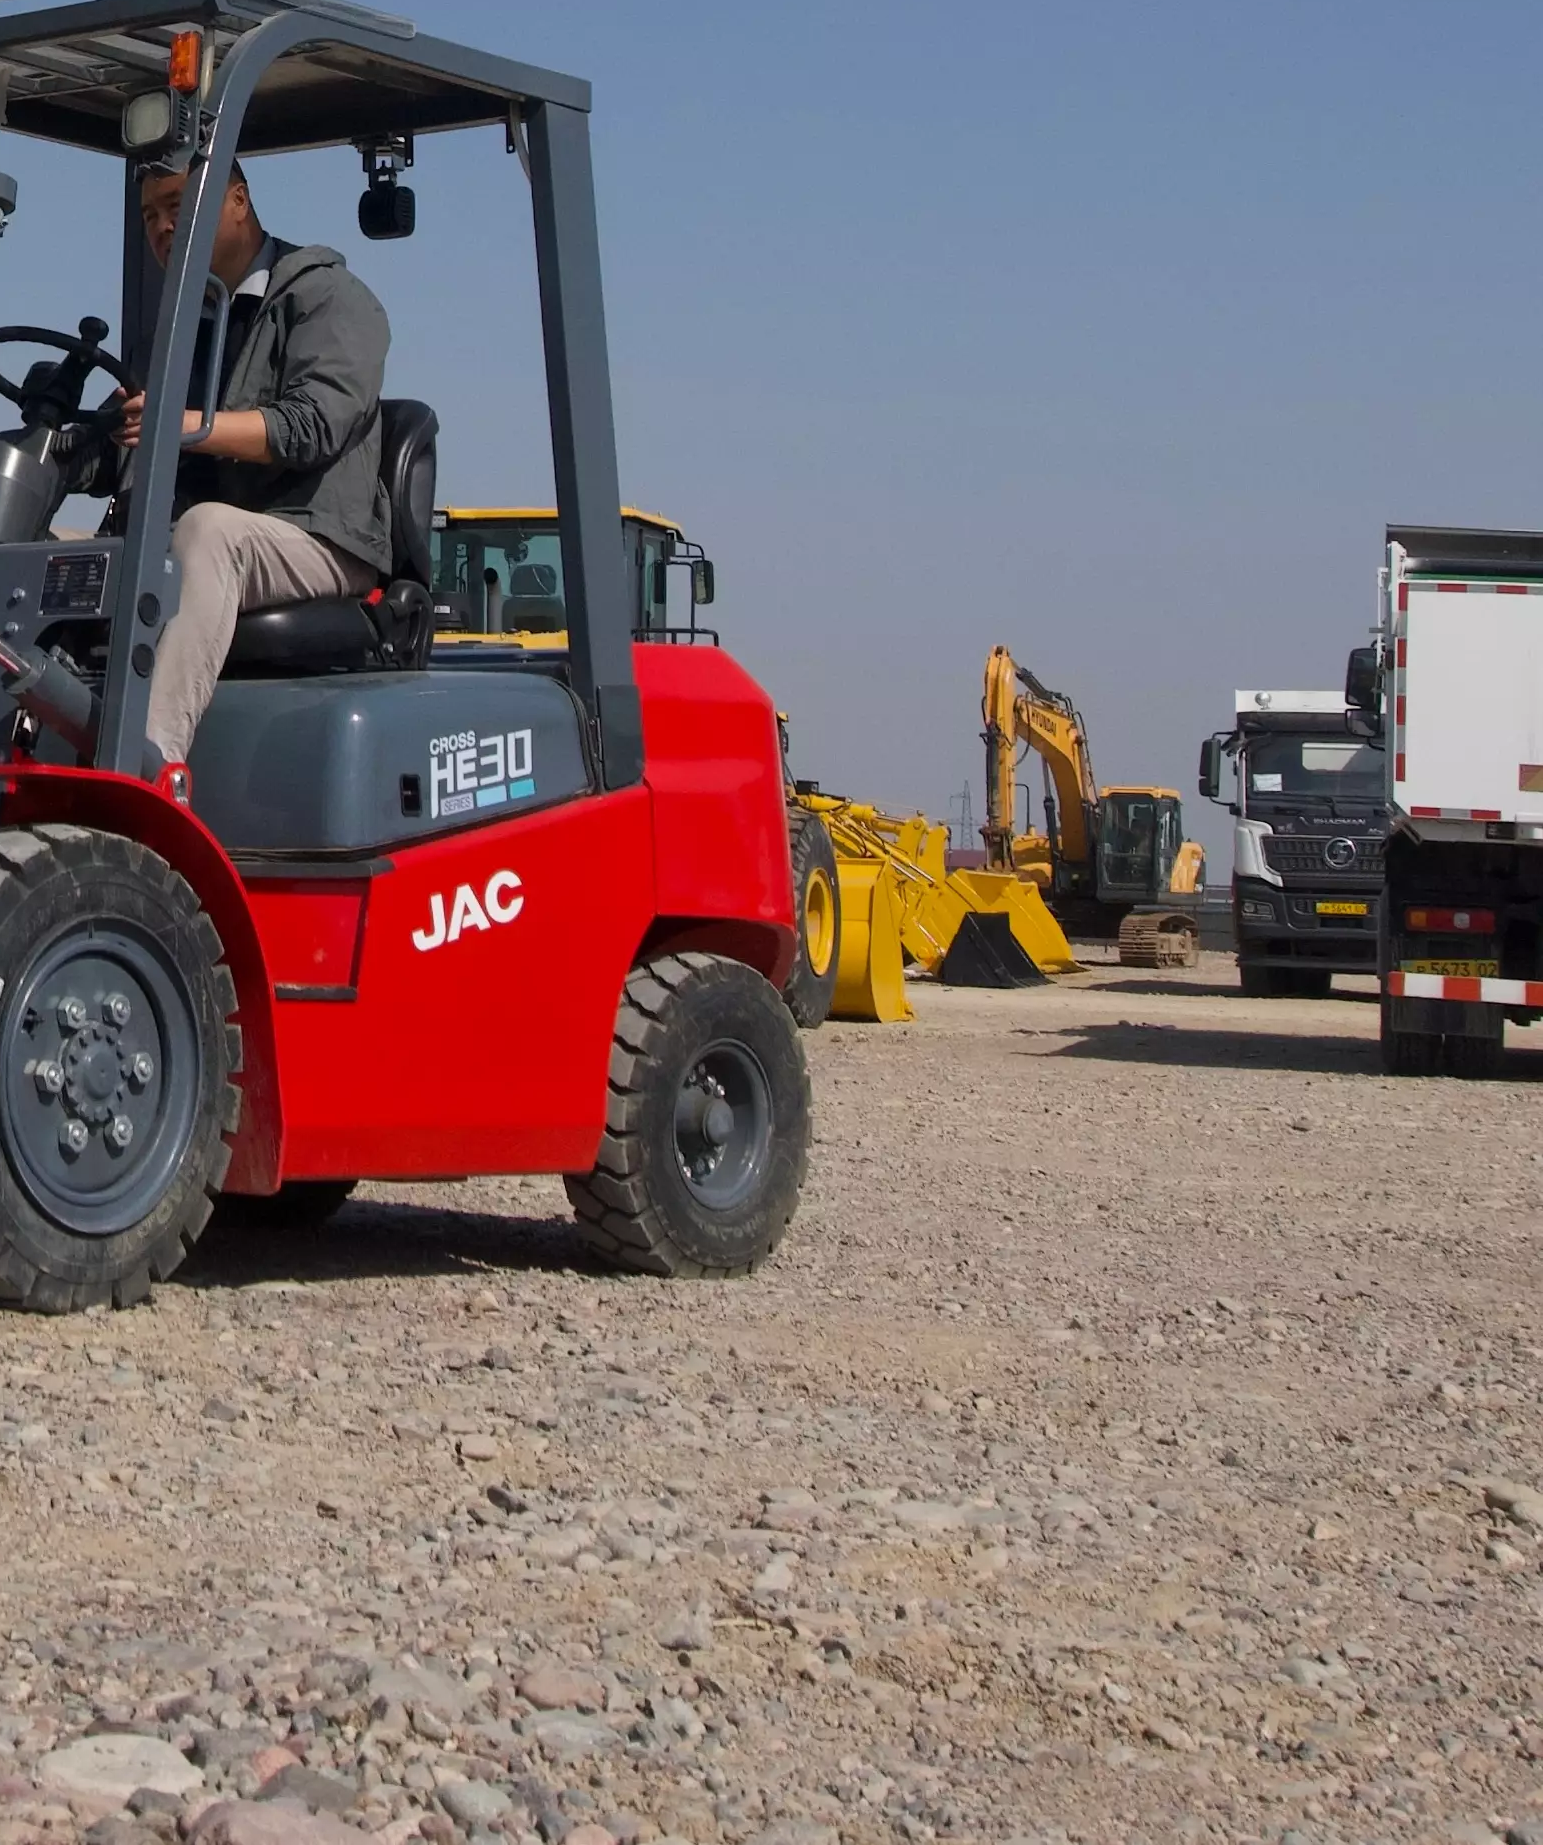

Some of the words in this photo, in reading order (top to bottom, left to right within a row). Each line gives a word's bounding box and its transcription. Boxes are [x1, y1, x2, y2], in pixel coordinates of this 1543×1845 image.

[430, 730, 476, 755] CROSS
[430, 728, 533, 819] HE30
[443, 795, 472, 814] SERIES
[412, 869, 524, 952] JAC
